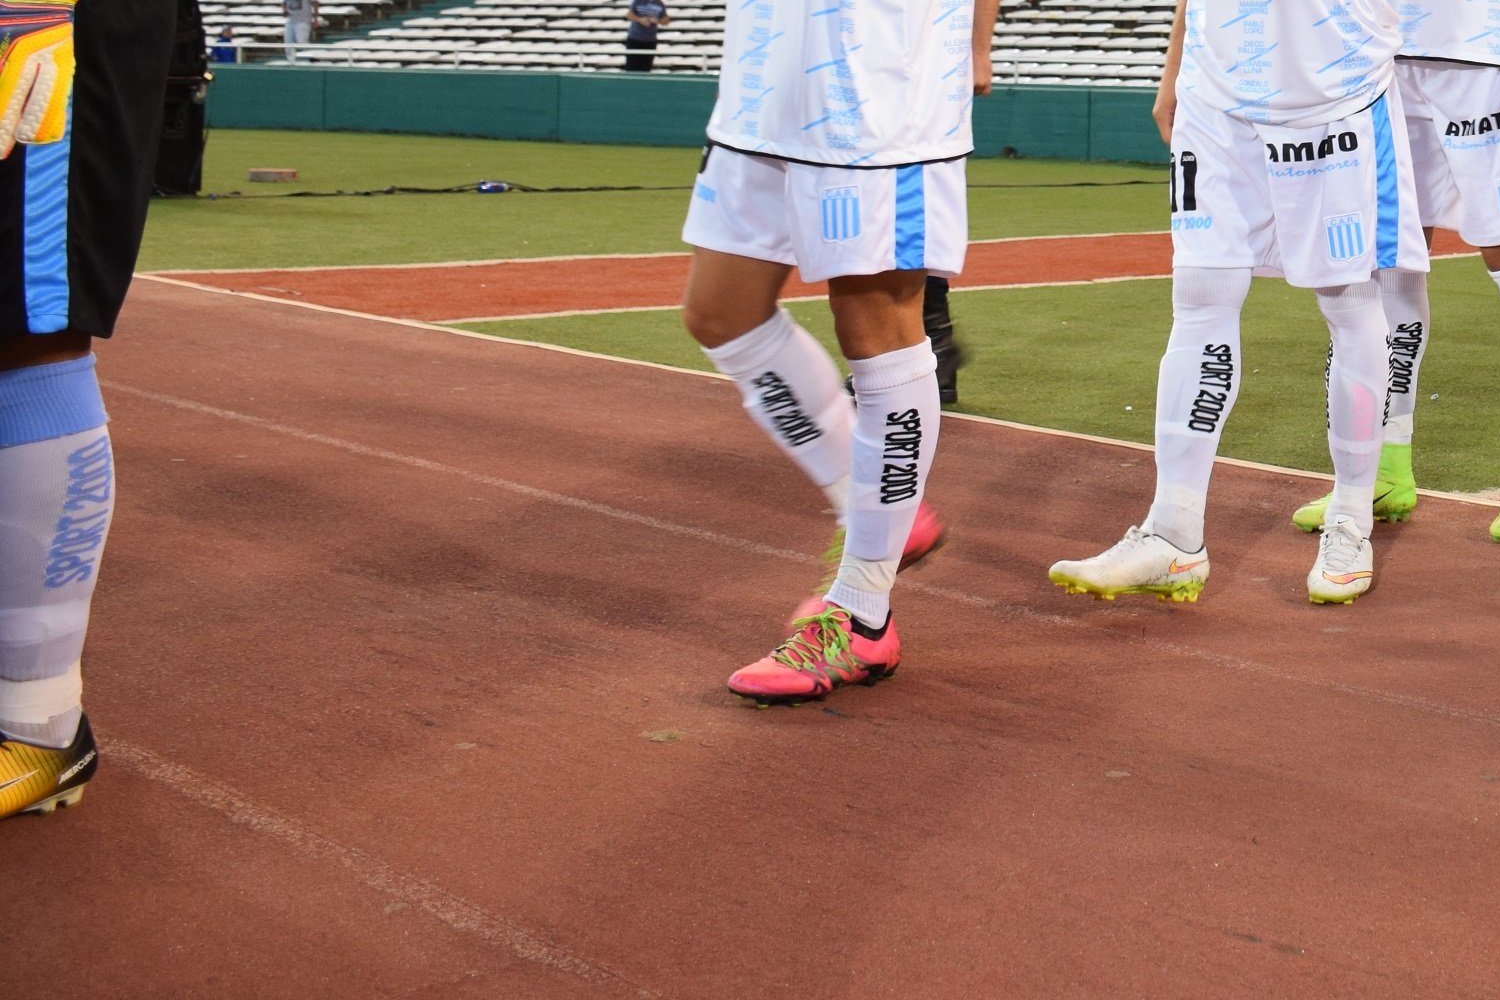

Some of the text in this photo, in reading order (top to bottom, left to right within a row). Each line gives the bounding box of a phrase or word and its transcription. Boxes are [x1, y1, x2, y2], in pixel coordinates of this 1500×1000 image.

[771, 408, 824, 448] 2000
[1187, 343, 1234, 434] SPORT 2000
[880, 408, 922, 505] SPORT 2000
[44, 508, 107, 590] SPORT
